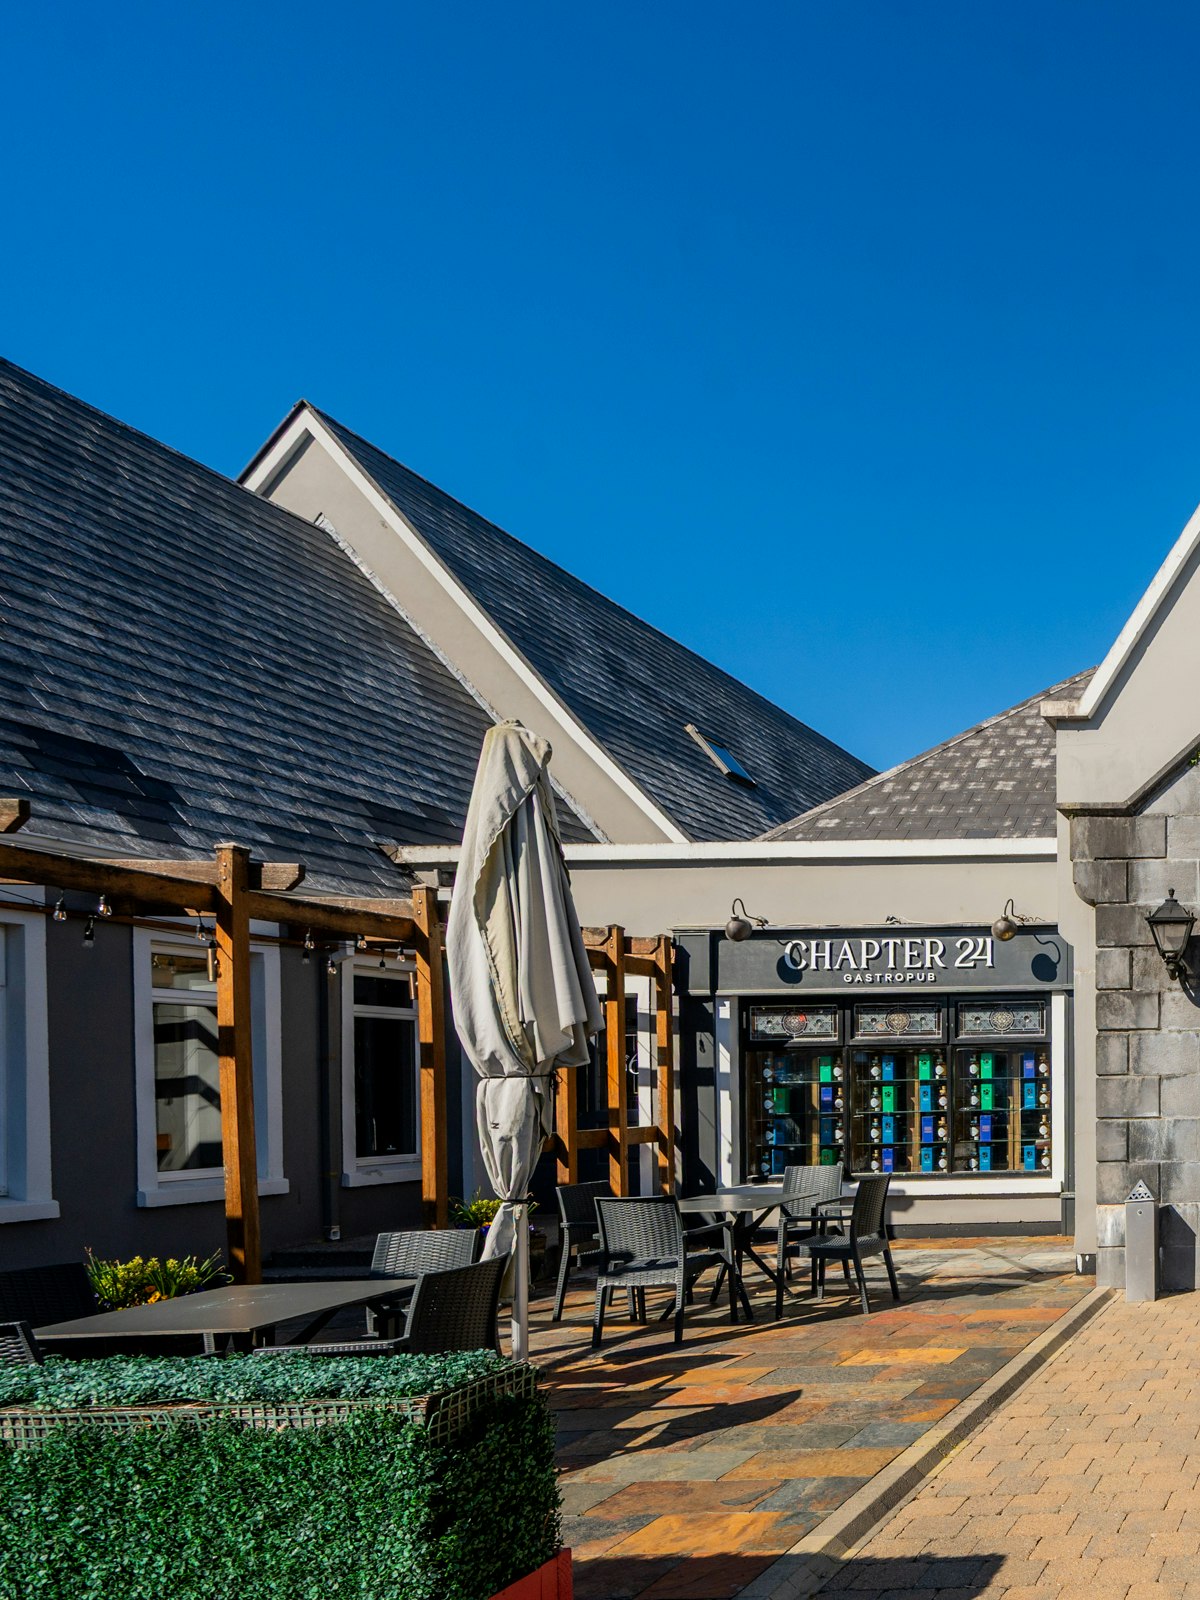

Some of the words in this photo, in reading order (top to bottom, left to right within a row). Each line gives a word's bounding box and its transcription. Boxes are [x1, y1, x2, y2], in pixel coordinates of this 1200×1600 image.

[784, 938, 947, 970] CHAPTER
[954, 937, 994, 968] 24
[843, 972, 937, 983] GASTROPUB
